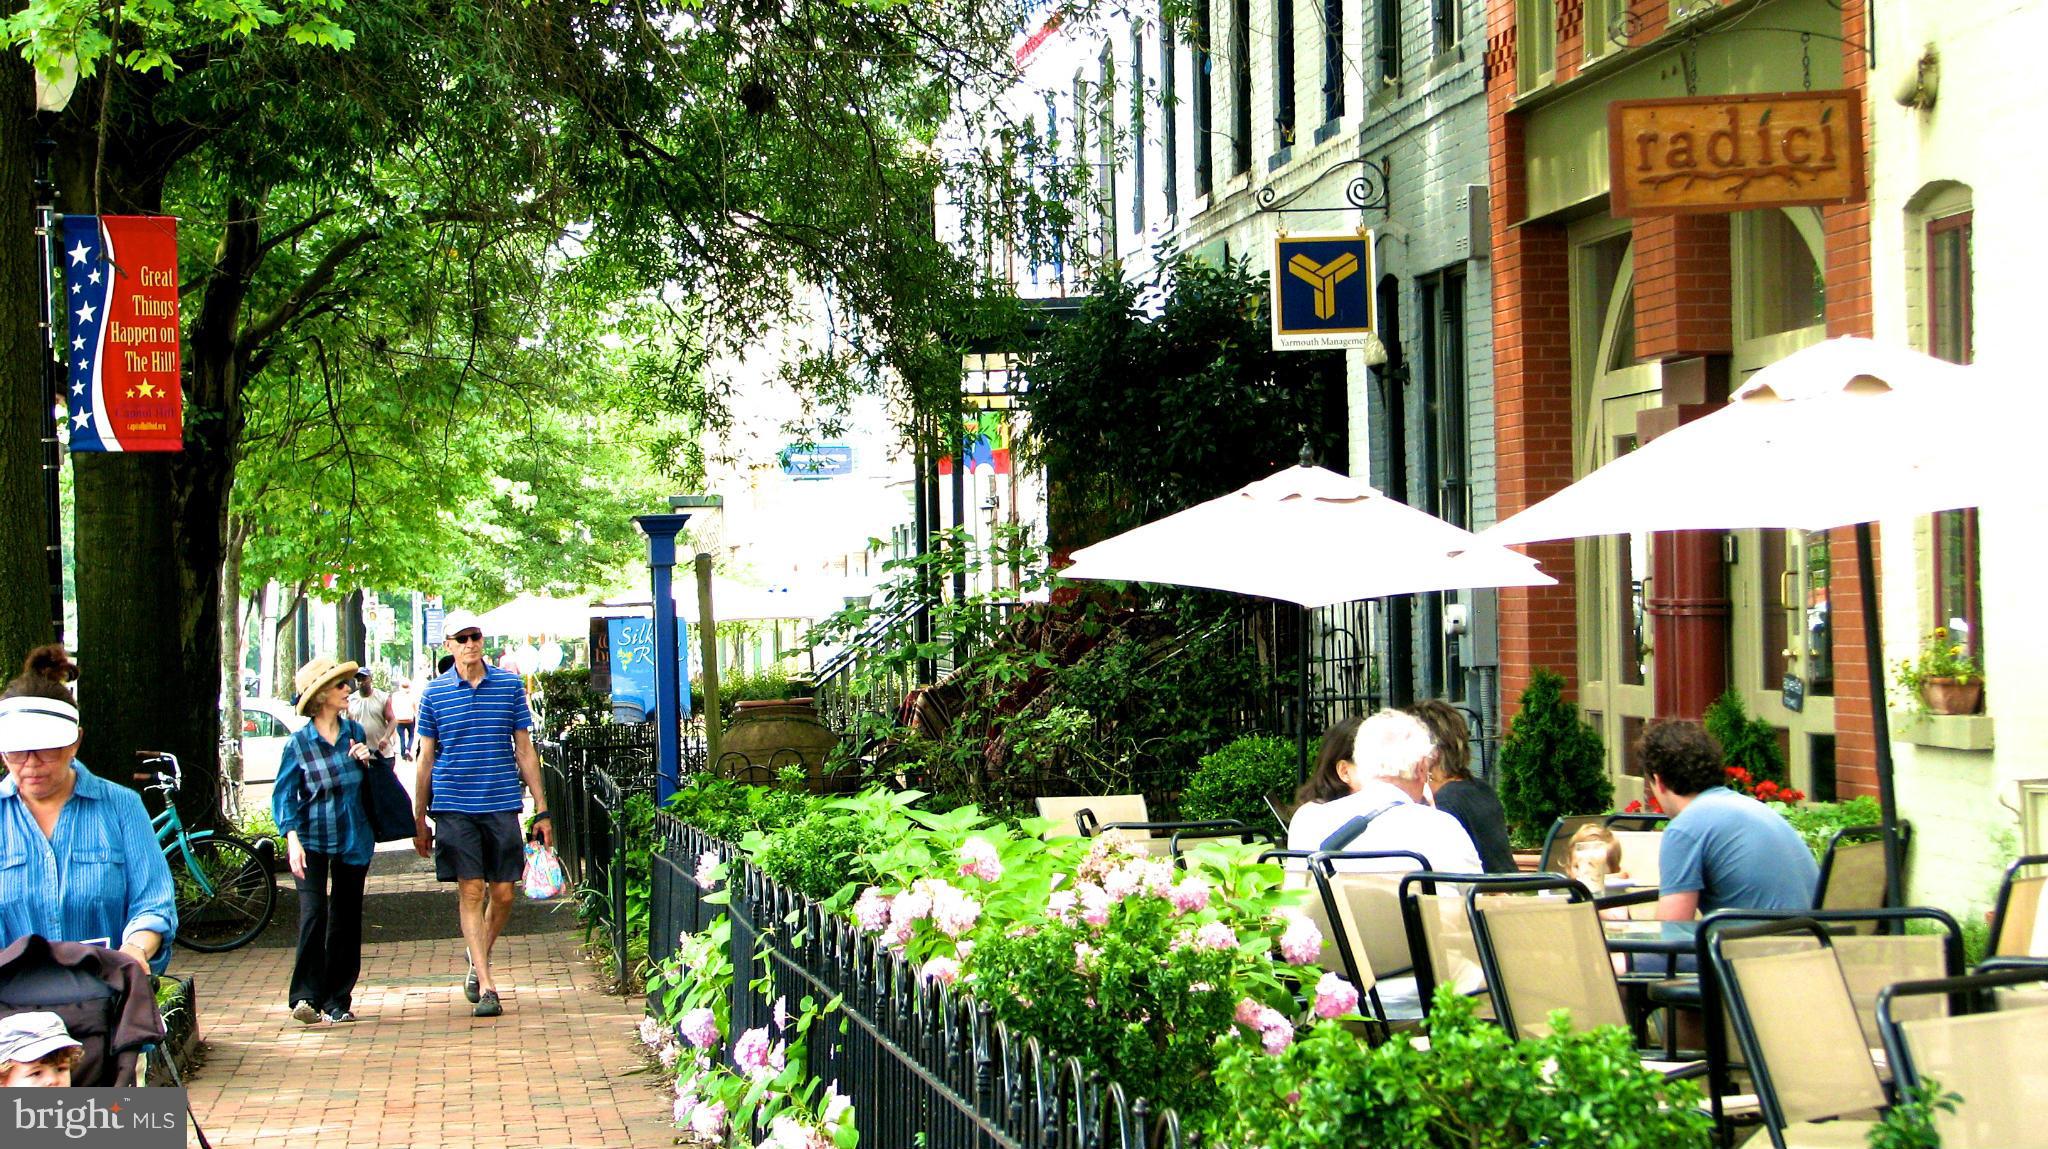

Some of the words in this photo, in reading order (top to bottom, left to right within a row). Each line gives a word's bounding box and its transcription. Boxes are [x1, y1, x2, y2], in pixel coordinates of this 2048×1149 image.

[1636, 106, 1837, 171] radici
[141, 266, 174, 287] Great
[132, 294, 175, 319] Things
[110, 321, 157, 346] Happen
[160, 327, 175, 342] on
[1280, 338, 1319, 347] Yarmouth
[1321, 337, 1368, 348] Managemen
[124, 351, 148, 372] The
[151, 351, 176, 372] Hill!
[618, 623, 654, 646] Silk
